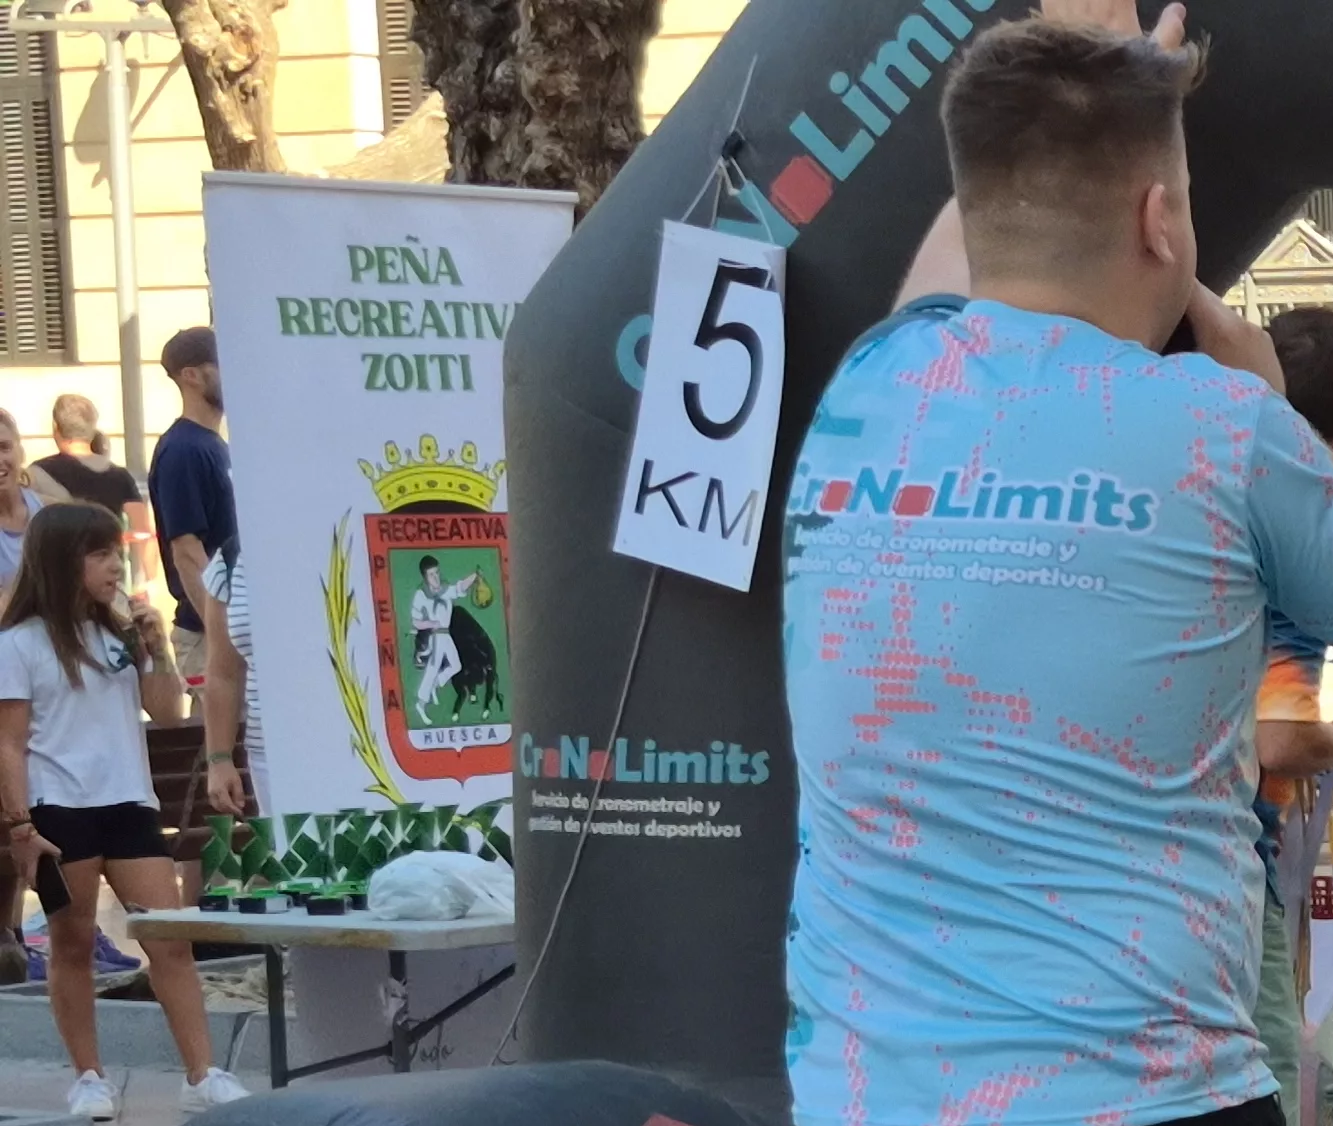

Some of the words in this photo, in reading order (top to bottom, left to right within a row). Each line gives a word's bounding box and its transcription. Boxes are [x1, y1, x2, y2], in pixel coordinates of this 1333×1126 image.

[346, 234, 464, 286] PEÑA
[683, 257, 775, 441] 5
[360, 353, 475, 392] ZOITI
[634, 458, 759, 547] KM
[377, 518, 508, 543] RECREATIVA
[856, 527, 884, 550] de
[888, 532, 1050, 558] cronometraje
[1060, 541, 1078, 563] y
[836, 555, 864, 576] de
[869, 560, 956, 582] eventos
[962, 561, 1106, 592] deportivos
[423, 727, 498, 745] HUESCA
[592, 796, 704, 816] ronometraje
[708, 799, 721, 817] y
[645, 819, 742, 838] deportivos
